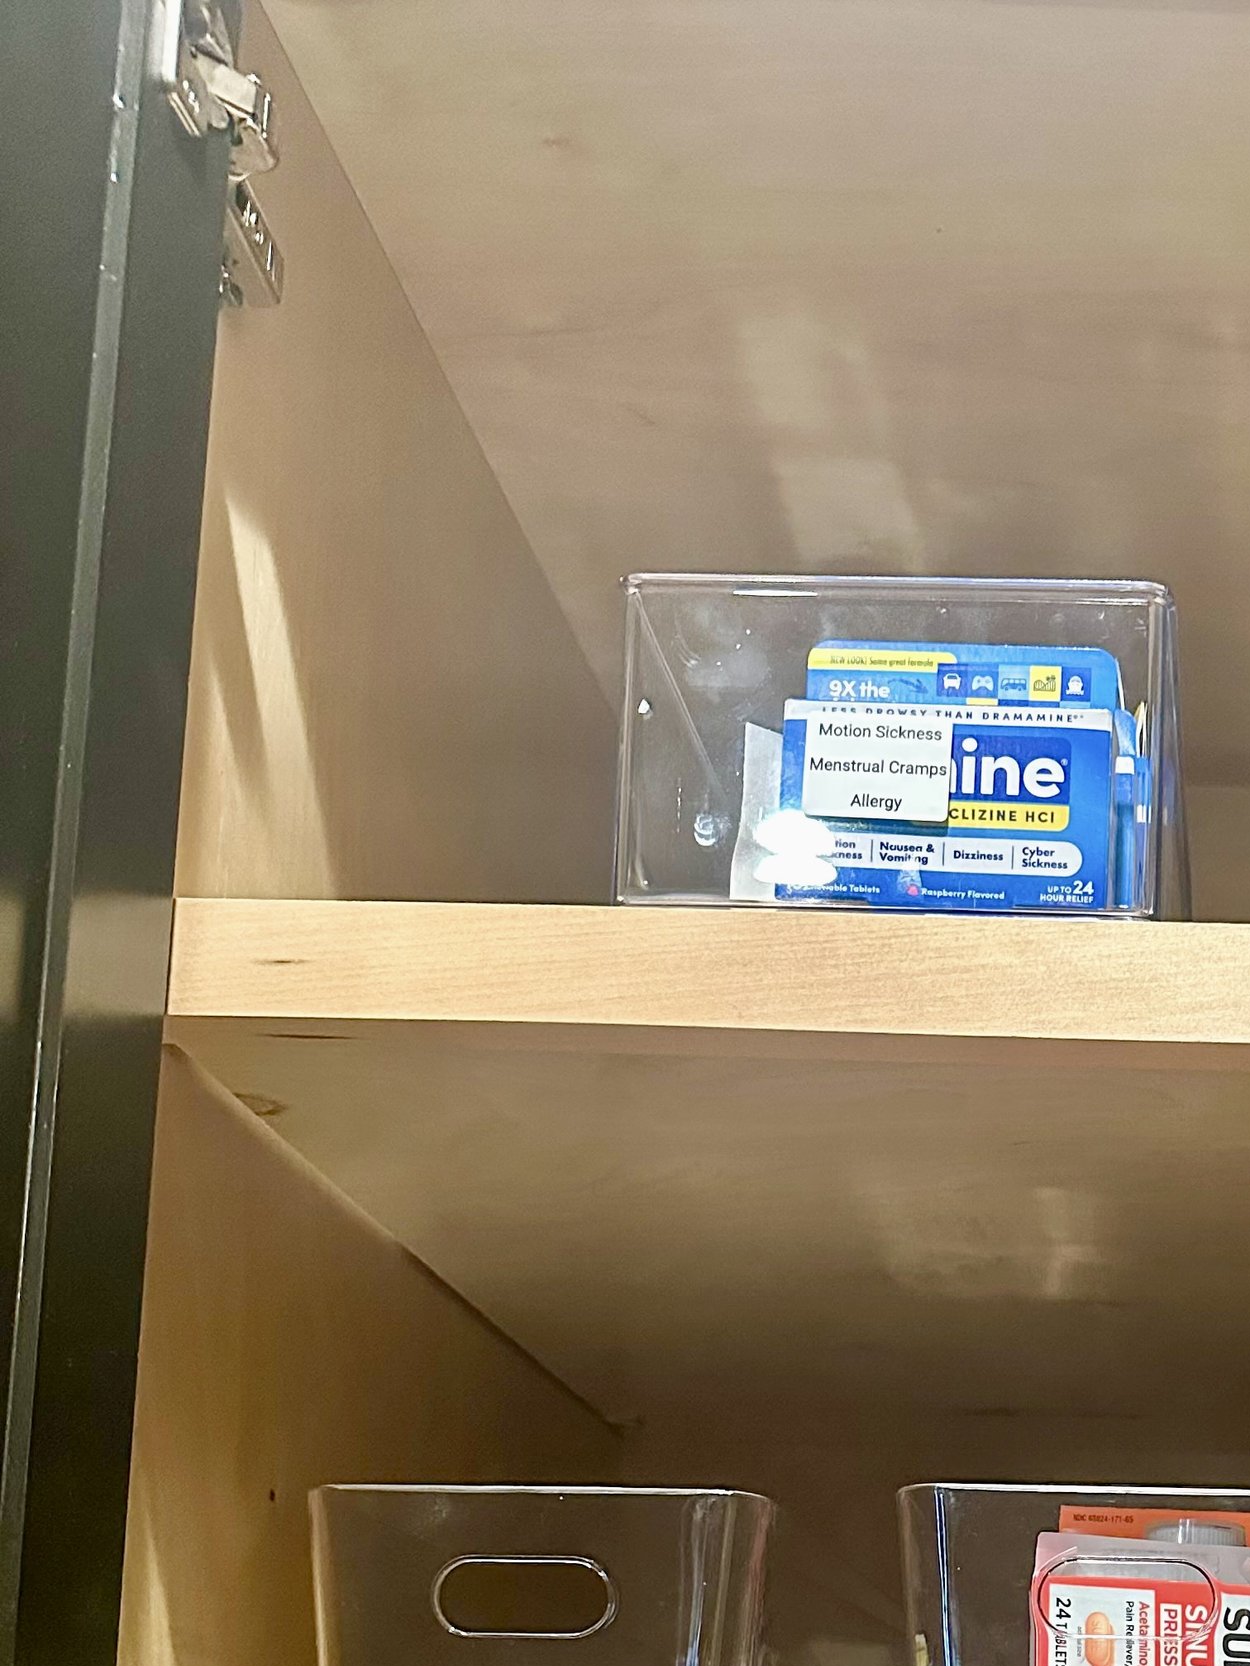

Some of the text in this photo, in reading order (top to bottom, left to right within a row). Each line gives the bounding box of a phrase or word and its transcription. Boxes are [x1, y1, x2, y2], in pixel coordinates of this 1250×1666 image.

[829, 679, 891, 697] 9X the
[935, 710, 973, 720] THAN
[818, 722, 943, 741] Motion Sickness
[809, 756, 948, 780] Menstrual Cramps
[849, 793, 903, 812] Allergy
[926, 844, 935, 853] &
[953, 850, 1004, 861] Dizziness
[1021, 846, 1056, 859] Cyber
[1021, 858, 1069, 869] Sickness
[921, 887, 1006, 900] Raspberry Flavored
[1048, 880, 1095, 896] UP TO 24
[1040, 893, 1095, 904] HOUR RELIEF
[1055, 1596, 1072, 1619] 24
[1125, 1600, 1136, 1623] Pain
